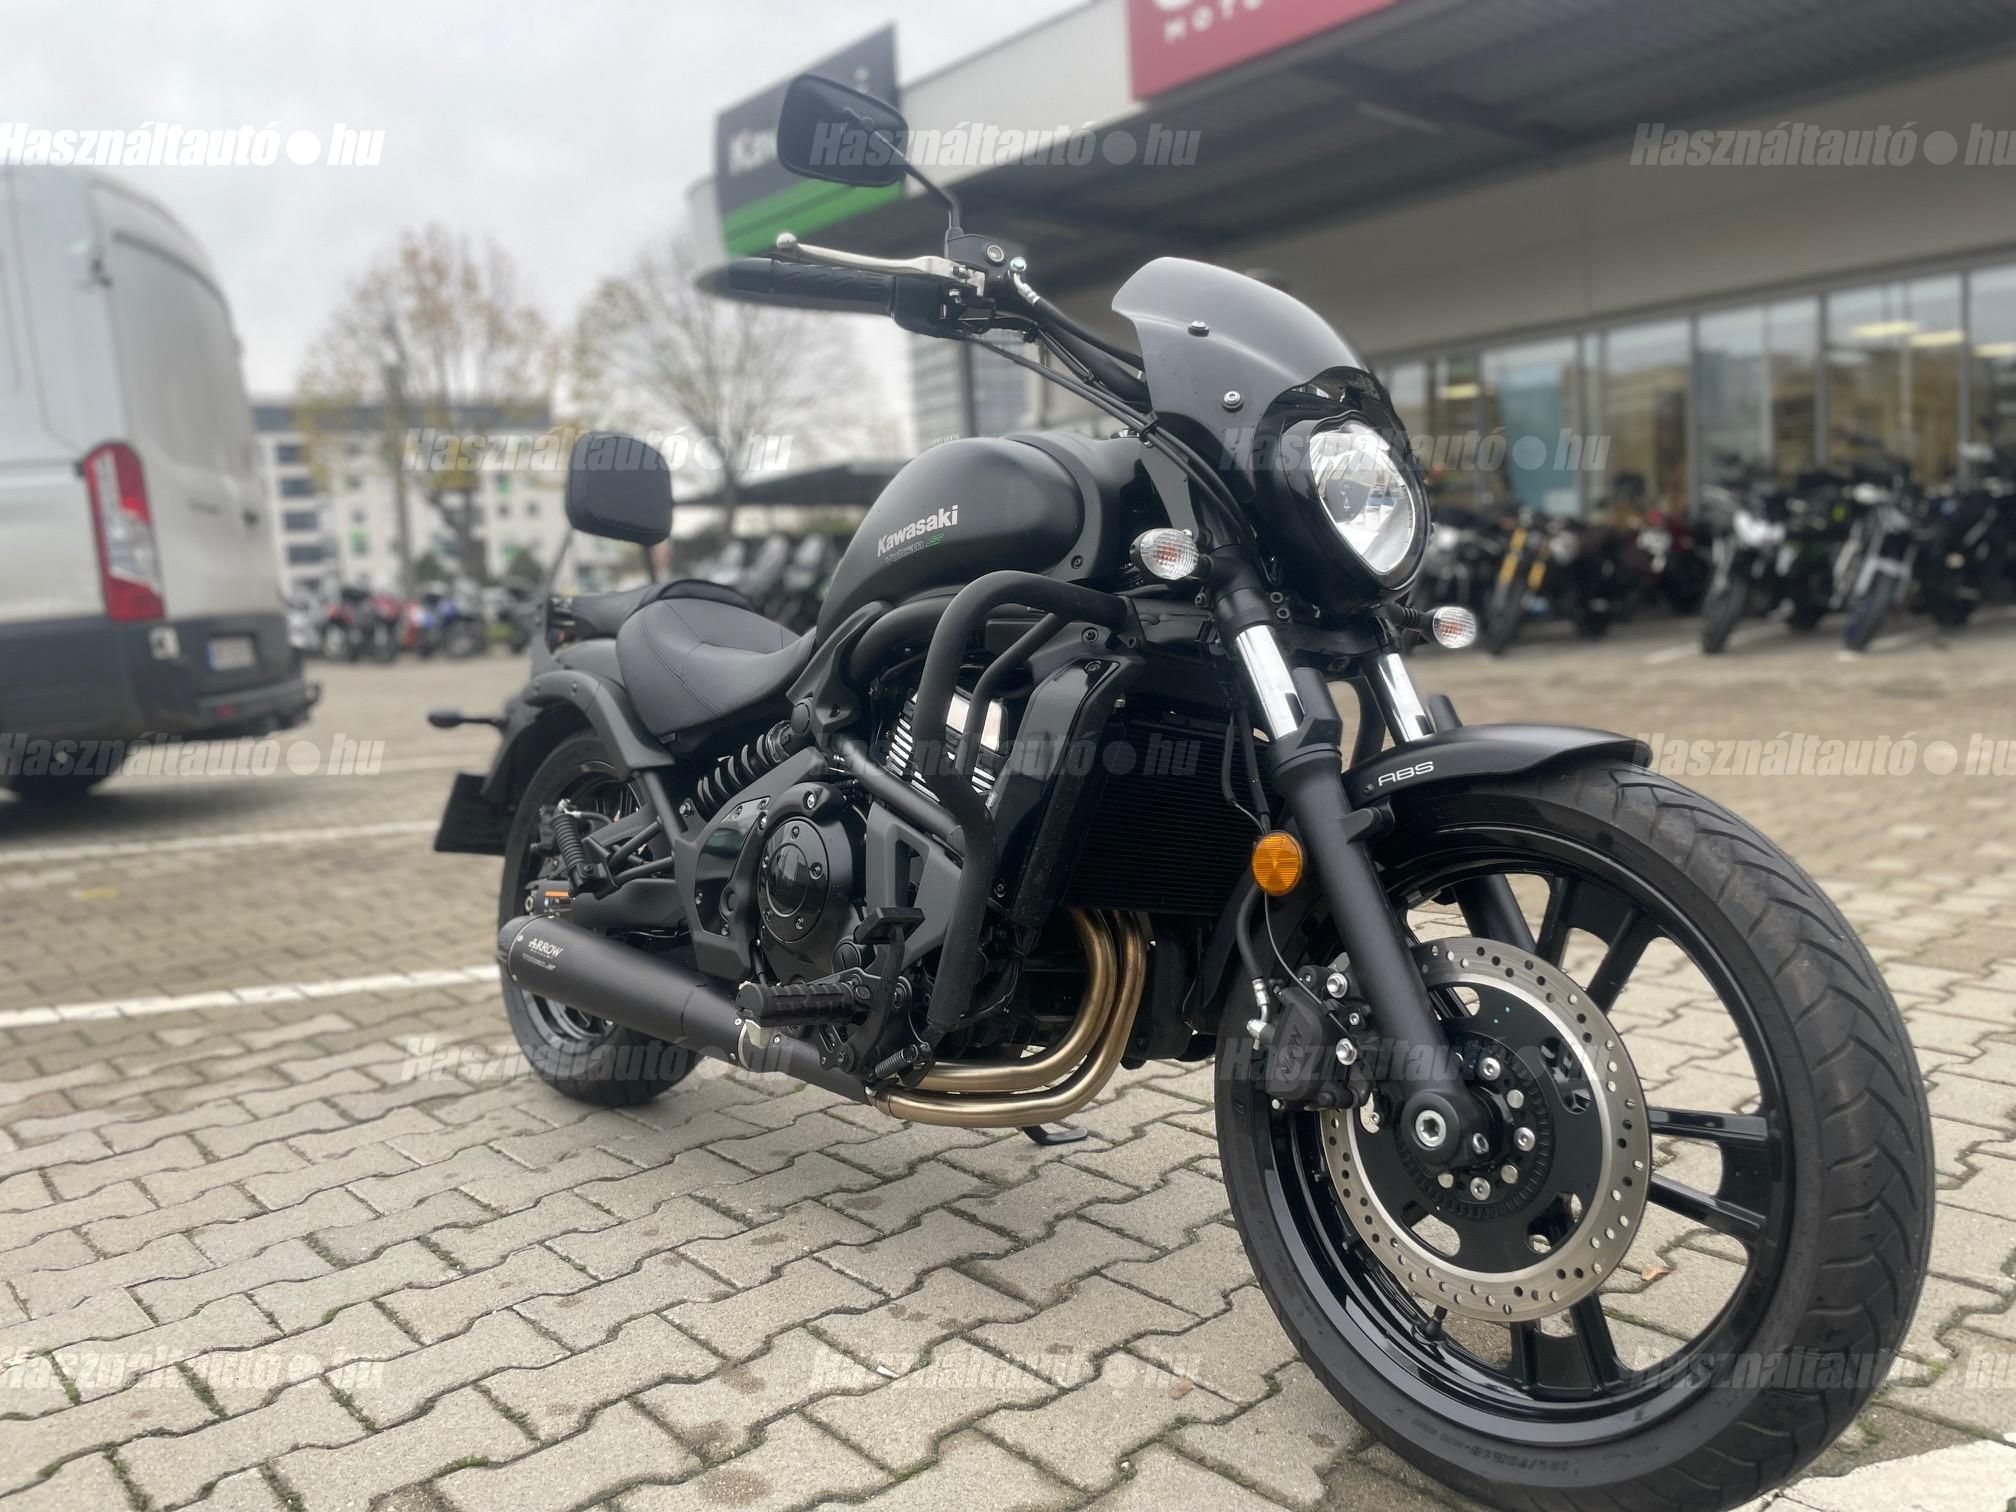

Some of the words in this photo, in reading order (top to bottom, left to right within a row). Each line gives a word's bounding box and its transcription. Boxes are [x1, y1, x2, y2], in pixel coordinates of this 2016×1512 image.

[877, 505, 959, 558] Kawasaki
[1377, 761, 1434, 787] ABS
[528, 938, 563, 958] ARROW
